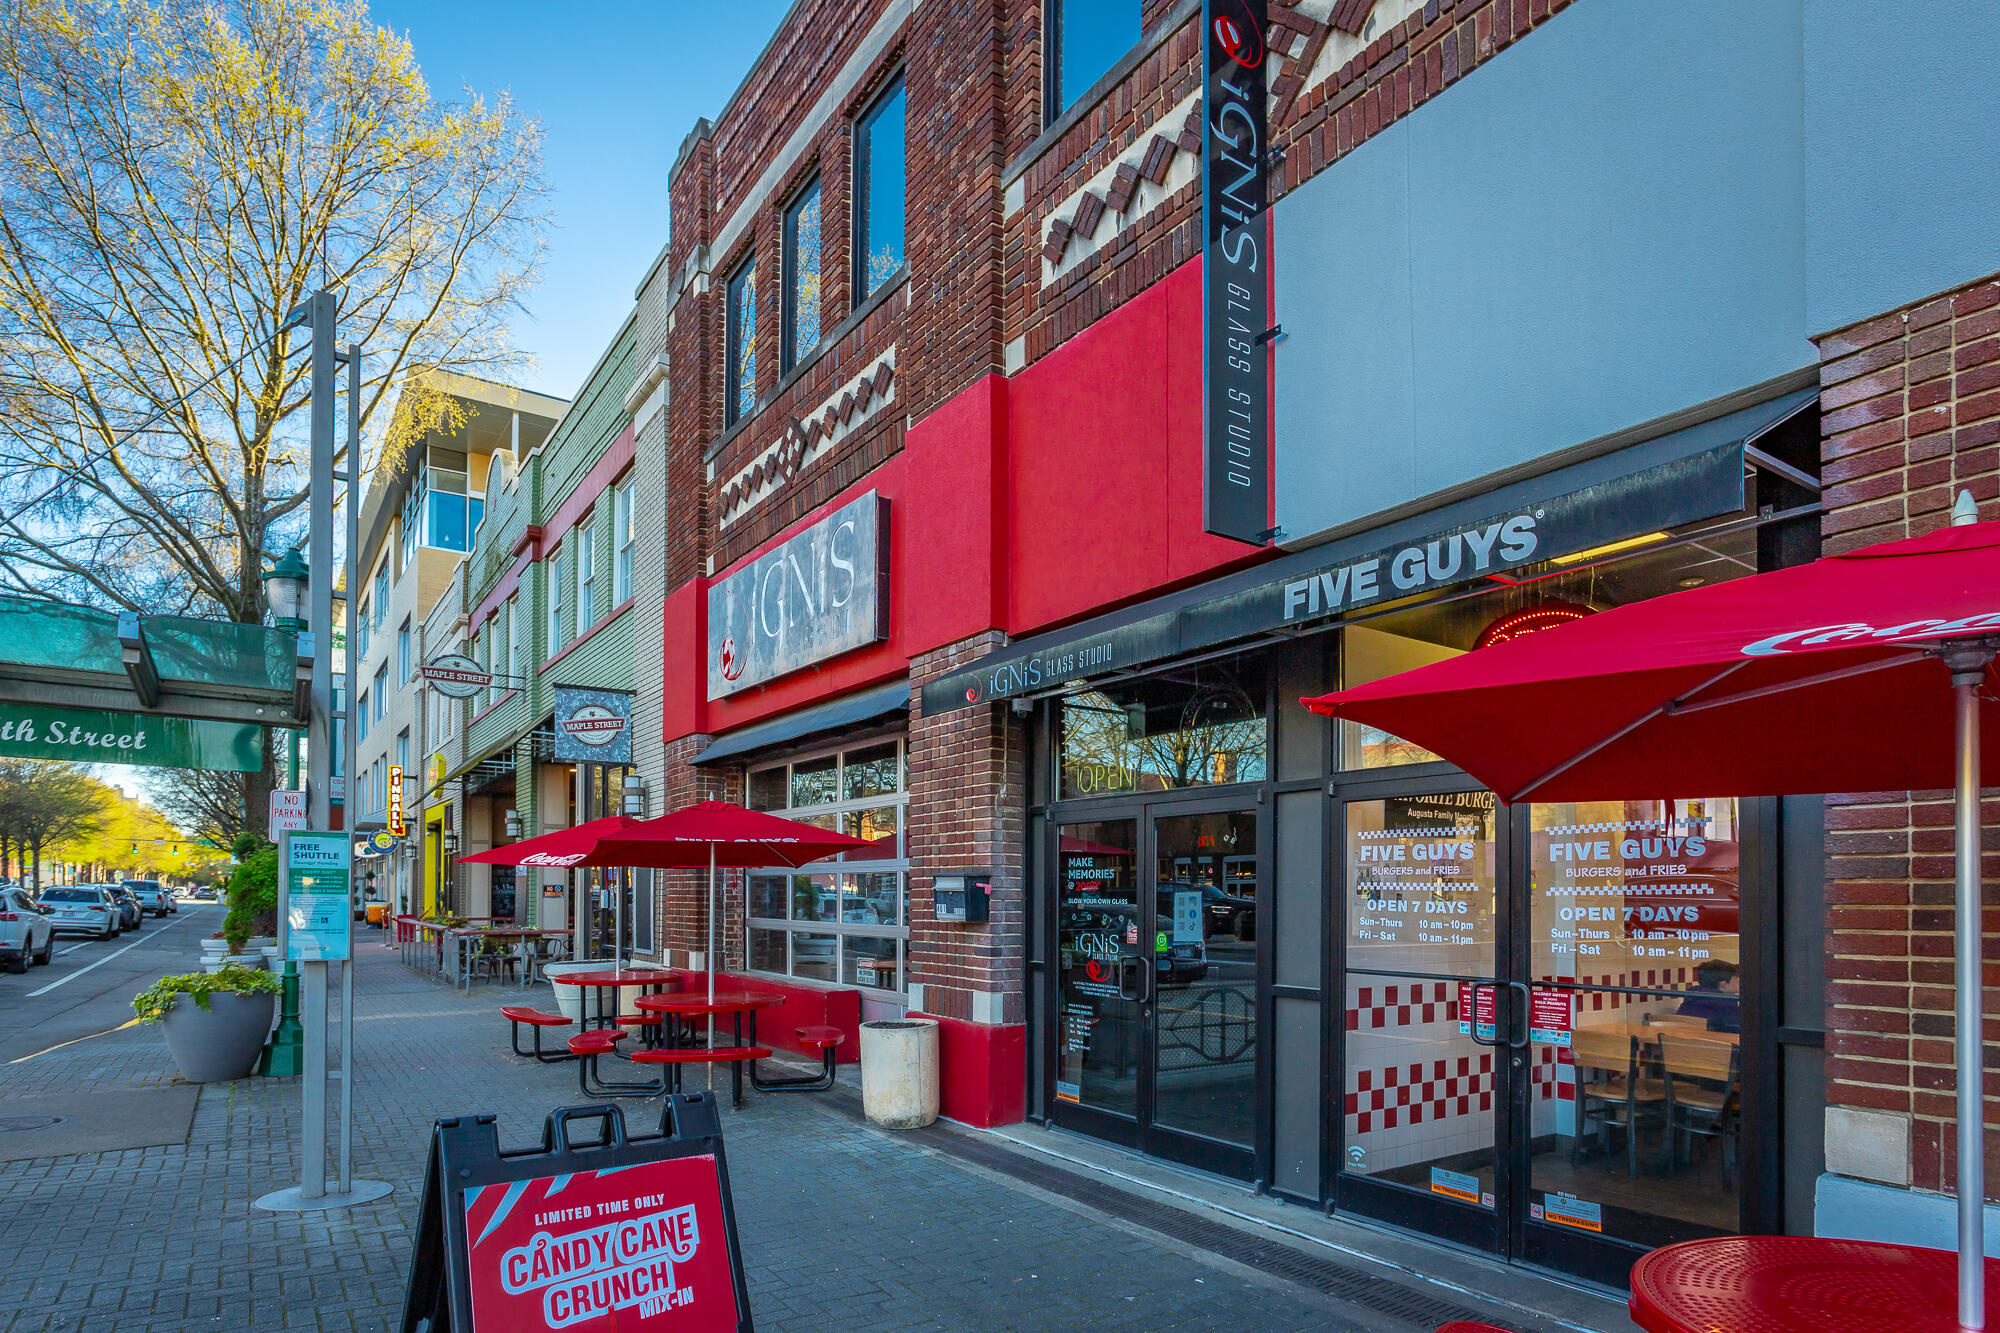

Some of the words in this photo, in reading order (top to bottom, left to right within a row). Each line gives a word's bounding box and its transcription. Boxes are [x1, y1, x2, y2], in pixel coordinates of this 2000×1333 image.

[1228, 282, 1251, 373] GLASS
[1228, 388, 1251, 487] STUDIO
[1283, 564, 1380, 621] FIVE
[1046, 654, 1074, 678] GLASS
[1079, 643, 1112, 669] STUDIO
[424, 669, 455, 680] MAPLE
[456, 673, 490, 684] STREET
[566, 722, 593, 731] MAPLE
[594, 720, 622, 729] STREET
[44, 721, 147, 750] Street
[1079, 764, 1133, 793] OPEN
[284, 795, 298, 806] NO
[391, 767, 401, 829] PINBALL
[1407, 808, 1433, 819] Augusta
[1434, 810, 1453, 822] Family
[283, 821, 298, 829] ANY
[294, 843, 320, 851] FREE
[1360, 844, 1406, 861] FIVE
[1549, 840, 1611, 862] FIVE
[1619, 836, 1707, 860] GUYS
[294, 851, 340, 860] SHUTTLE
[1068, 857, 1093, 868] MAKE
[1068, 869, 1115, 880] MEMORIES
[1372, 866, 1414, 876] BURGERS
[1415, 866, 1431, 875] and
[1433, 865, 1461, 875] FRIES
[1565, 866, 1622, 878] BURGERS
[1624, 865, 1647, 876] and
[1650, 864, 1687, 875] FRIES
[1068, 881, 1075, 890] @
[1366, 899, 1408, 912] OPEN
[1412, 901, 1421, 913] 7
[1425, 901, 1468, 914] DAYS
[1559, 906, 1616, 921] OPEN
[1621, 907, 1634, 921] 7
[1640, 906, 1699, 922] DAYS
[1419, 919, 1428, 929] 10
[1430, 921, 1443, 929] am
[1359, 930, 1372, 939] Fri
[1379, 931, 1396, 941] Sat
[1418, 932, 1428, 942] 10
[1430, 935, 1443, 943] am
[1631, 929, 1645, 940] 10
[1648, 931, 1665, 940] am
[1551, 943, 1567, 954] Fri
[1579, 944, 1601, 955] Sat
[1632, 945, 1645, 956] 10
[1648, 948, 1666, 957] am
[1442, 1186, 1477, 1200] TRESPASSING
[534, 1205, 592, 1227] LIMITED
[596, 1199, 630, 1215] TIME
[634, 1193, 665, 1210] ONLY
[1558, 1216, 1600, 1229] TRESPASSING
[506, 1231, 611, 1288] CANDY
[620, 1211, 697, 1257] CANE
[550, 1260, 669, 1323] CRUNCH
[639, 1286, 695, 1320] MIX-IN
